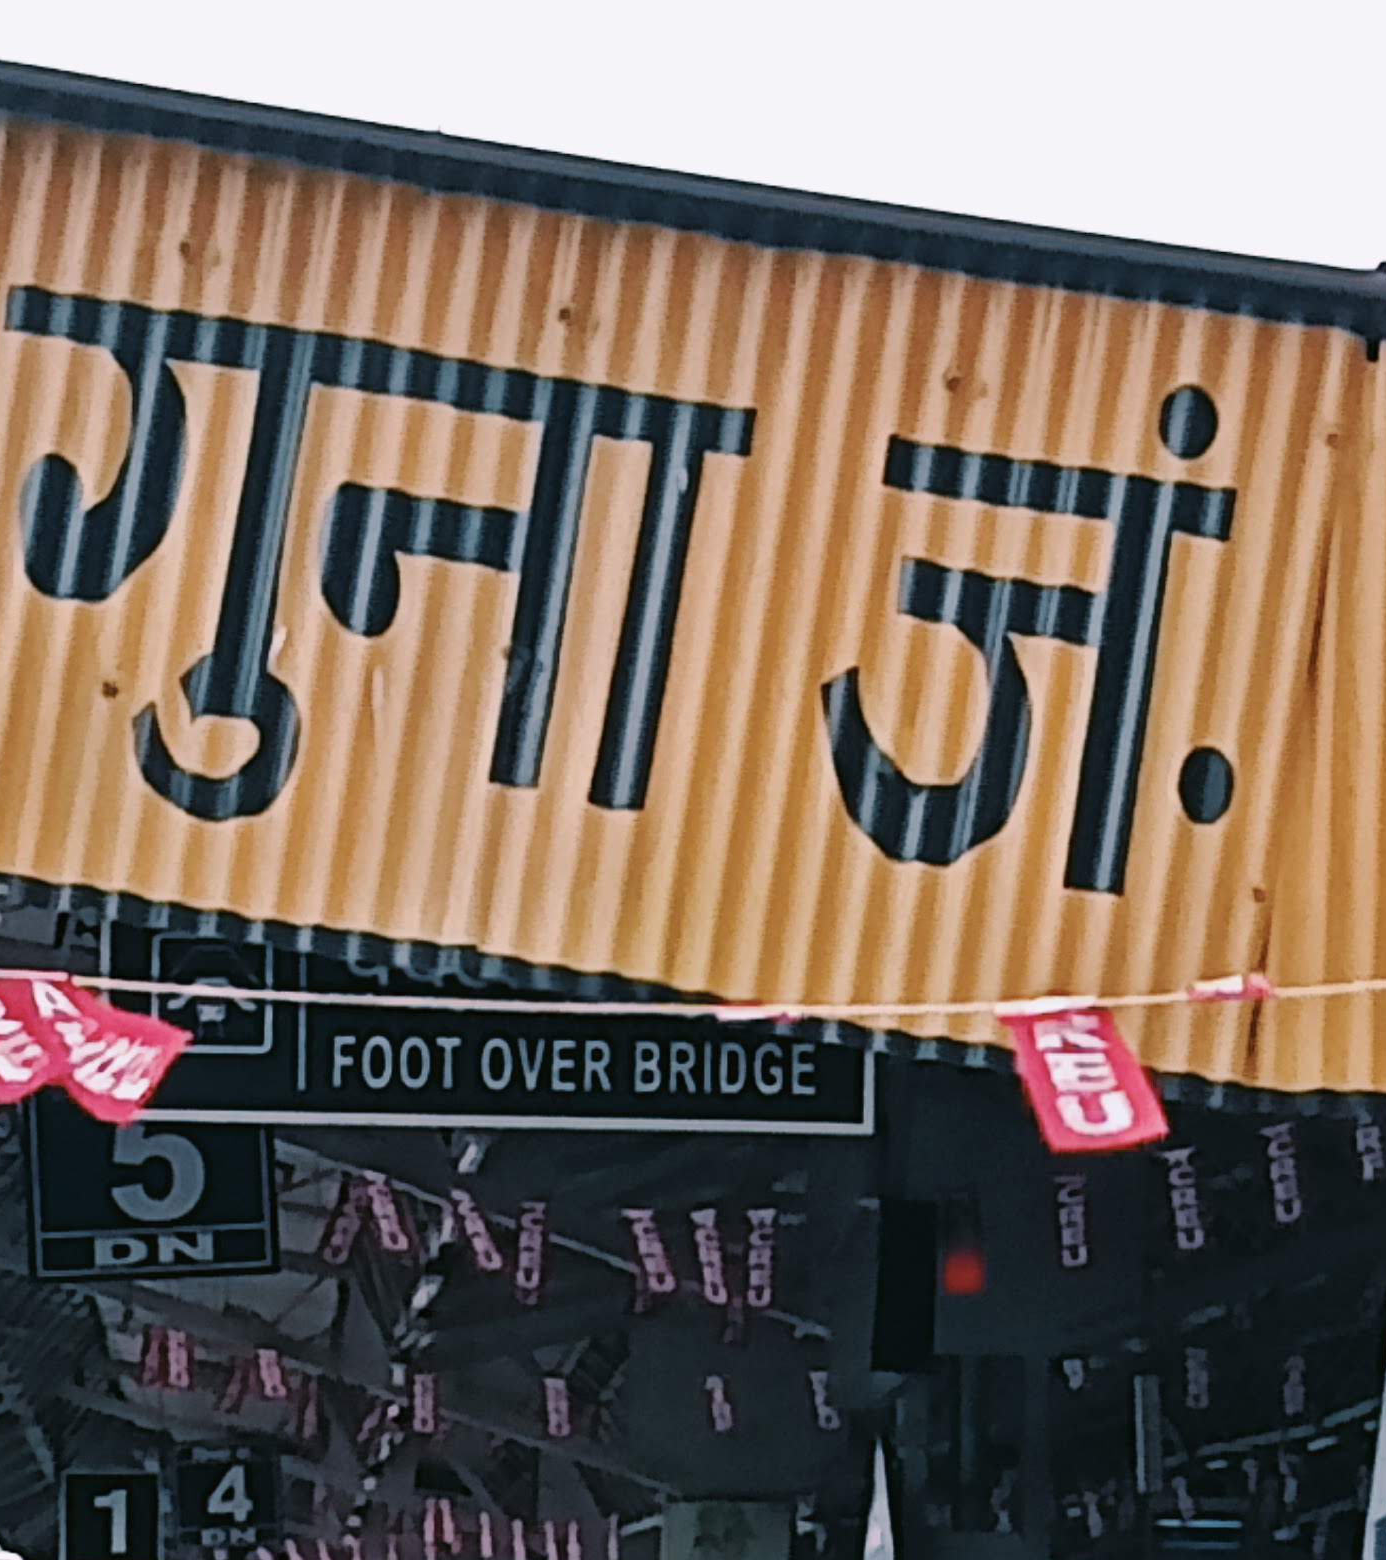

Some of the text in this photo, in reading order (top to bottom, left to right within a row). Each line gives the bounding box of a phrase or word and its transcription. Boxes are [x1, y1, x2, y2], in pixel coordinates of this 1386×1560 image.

[4, 284, 757, 822] गुना
[331, 1034, 818, 1097] FOOT OVER BRIDGE
[110, 1122, 206, 1223] 5
[93, 1230, 214, 1267] DN
[93, 1488, 129, 1555] 1
[206, 1463, 254, 1524] 4
